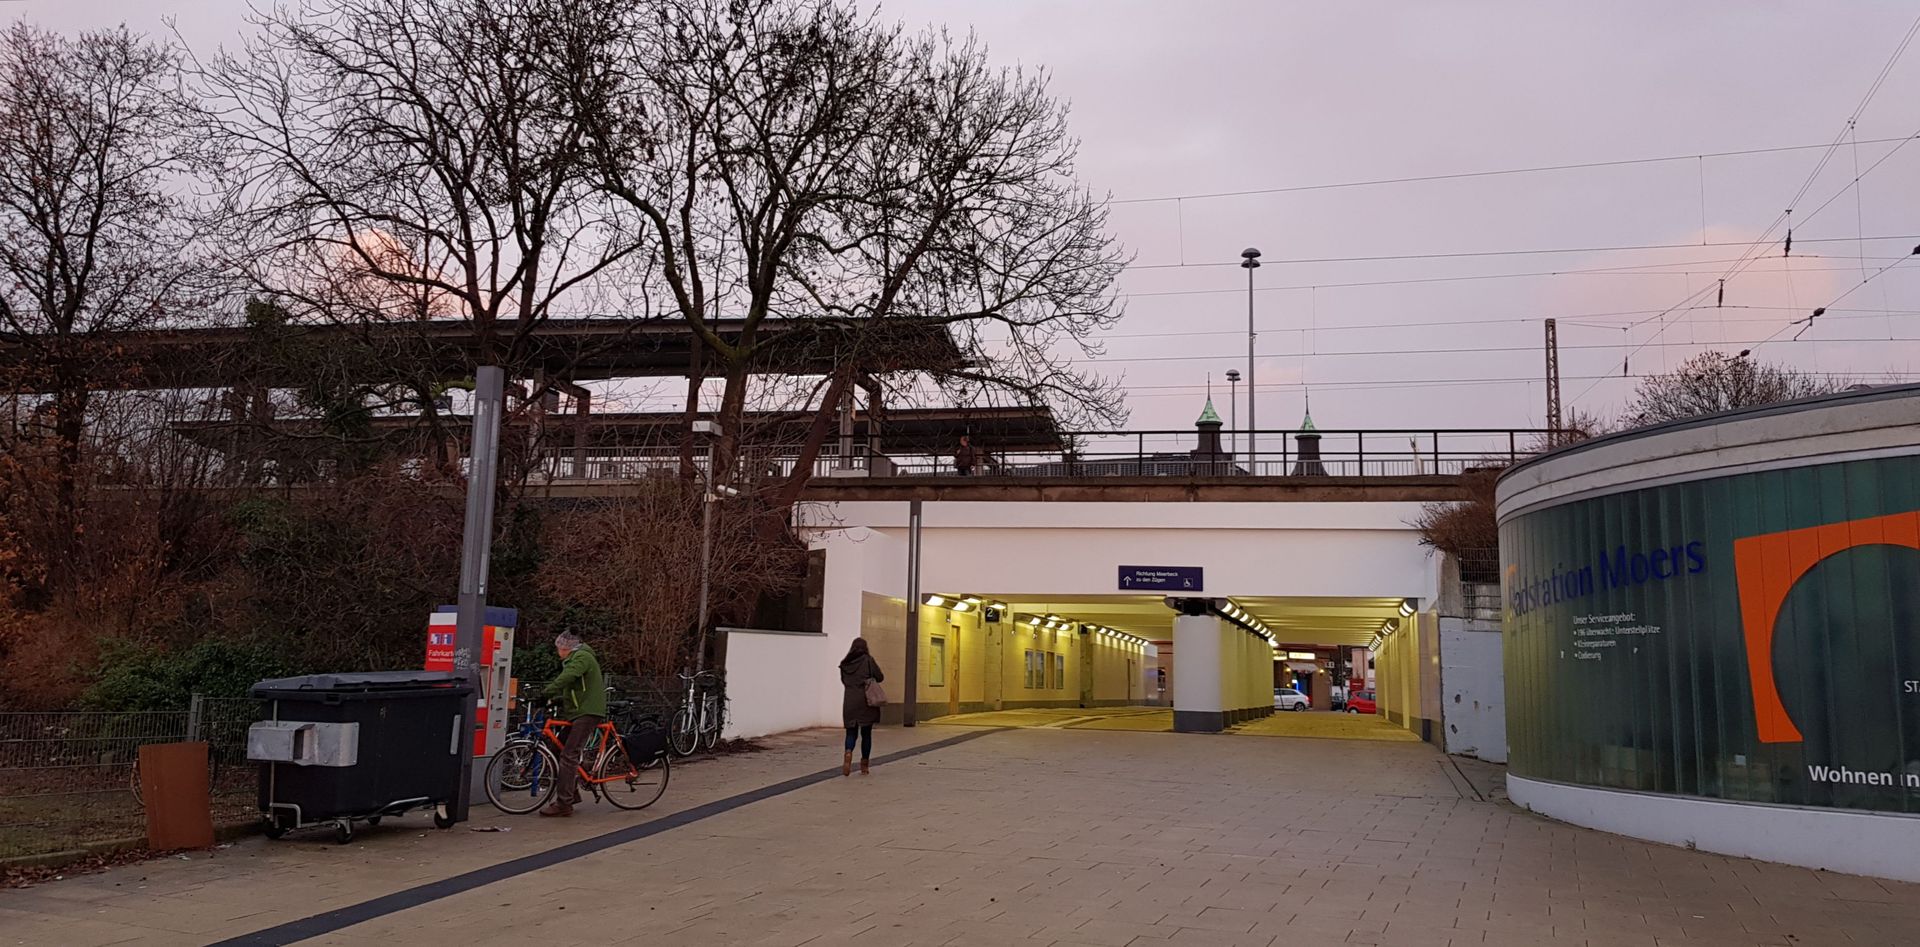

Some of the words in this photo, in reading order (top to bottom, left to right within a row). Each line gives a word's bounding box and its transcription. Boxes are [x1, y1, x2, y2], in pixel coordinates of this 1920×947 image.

[1600, 541, 1706, 590] Moers
[987, 608, 993, 617] 2
[1573, 616, 1587, 624] Unser
[1904, 681, 1920, 692] ST
[1808, 765, 1893, 785] Wohnen
